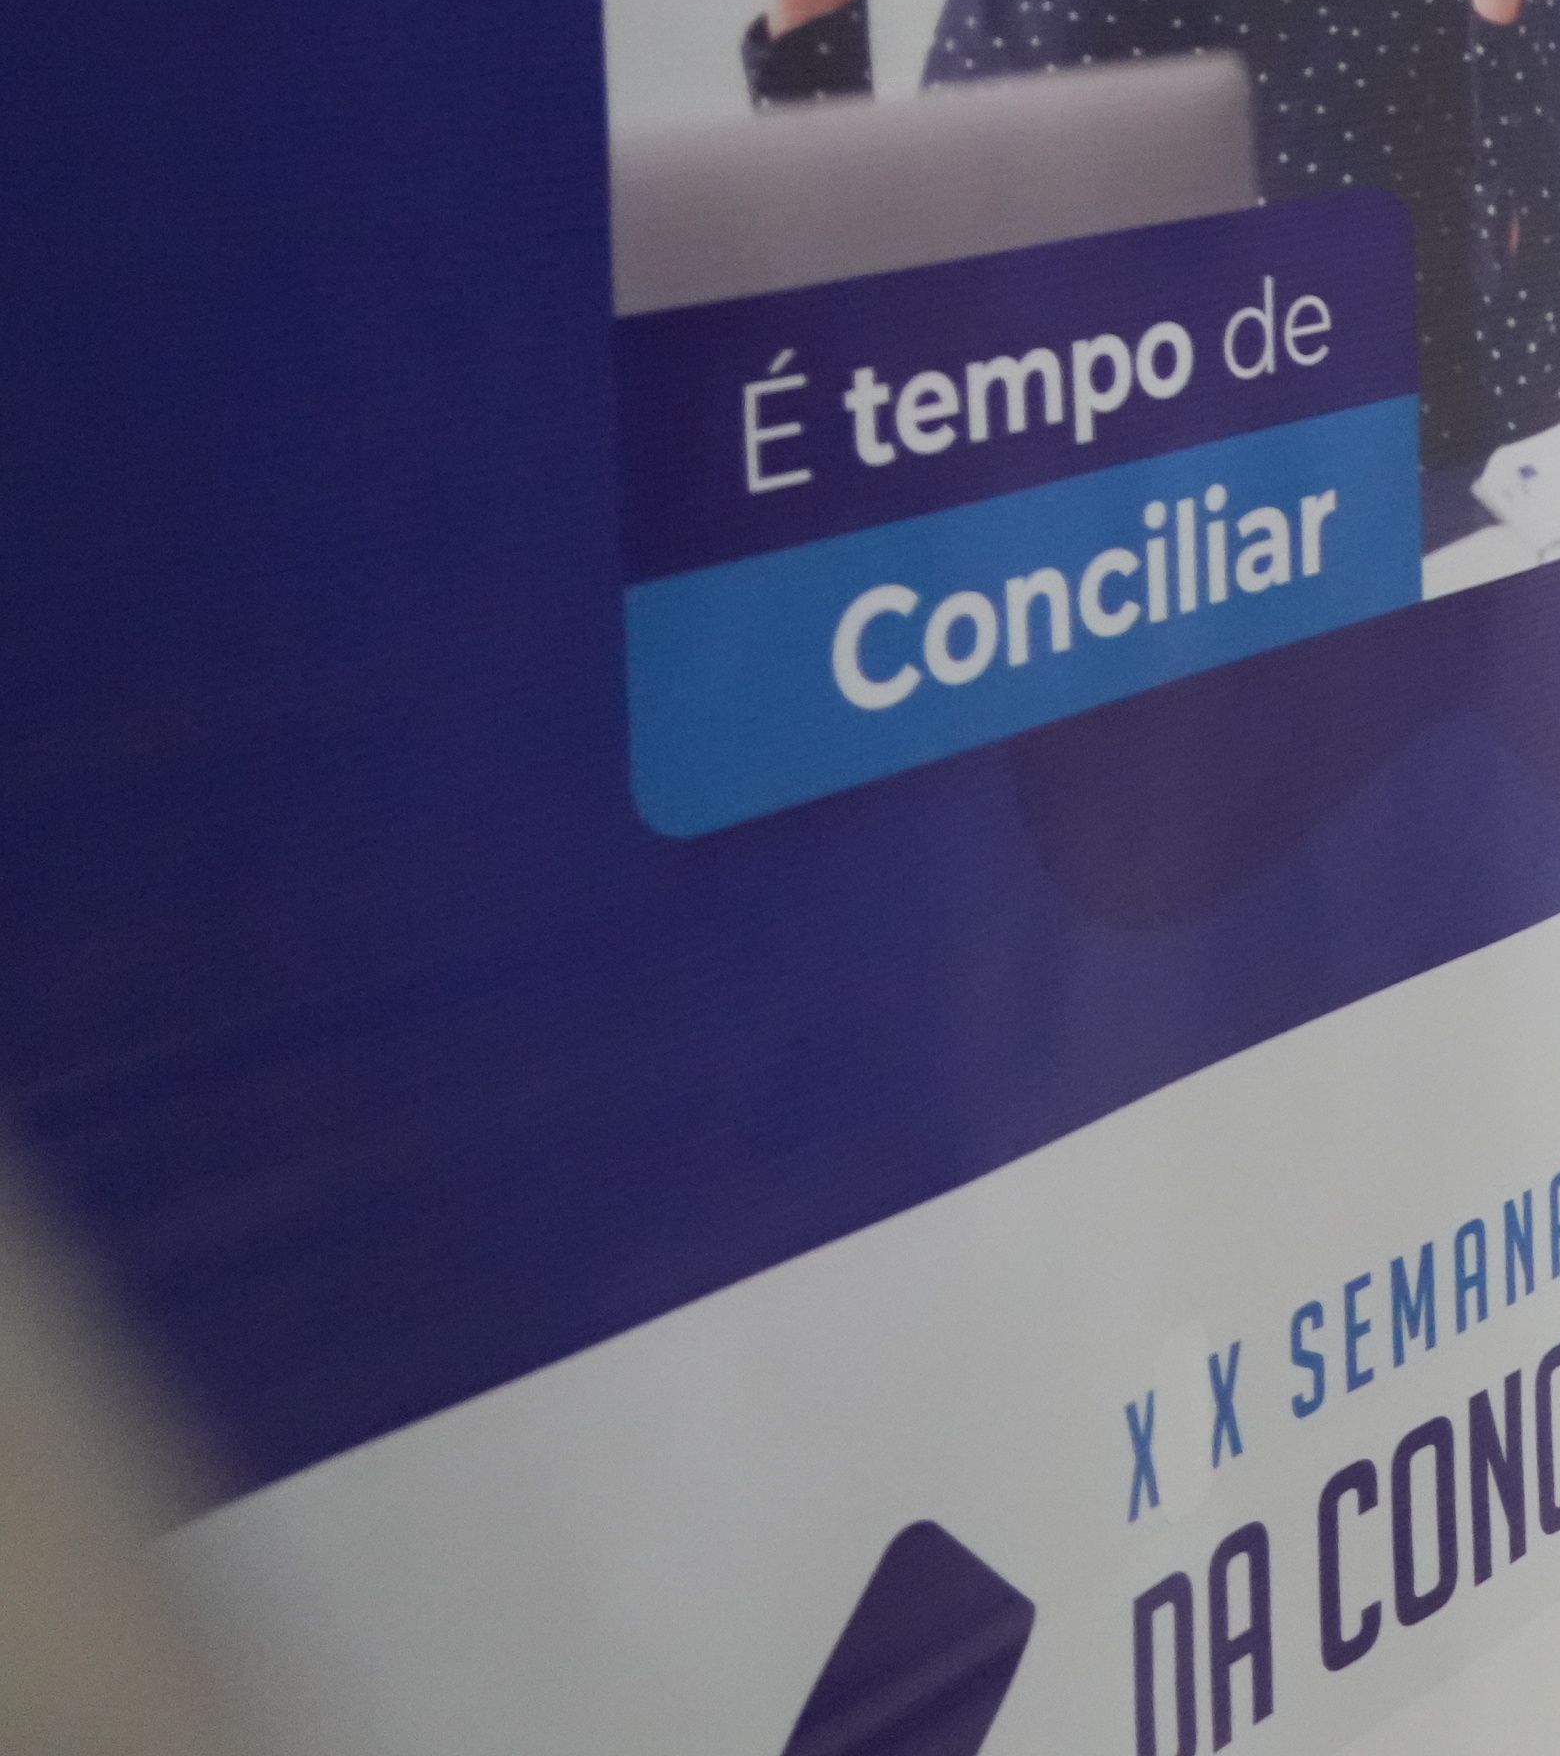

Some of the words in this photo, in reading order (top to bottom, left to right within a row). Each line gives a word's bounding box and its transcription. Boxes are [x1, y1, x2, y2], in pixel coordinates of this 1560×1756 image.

[742, 348, 812, 494] É
[844, 321, 1194, 467] tempo
[1223, 275, 1332, 380] de
[831, 483, 1337, 710] Conciliar
[1132, 1521, 1274, 1756] DA
